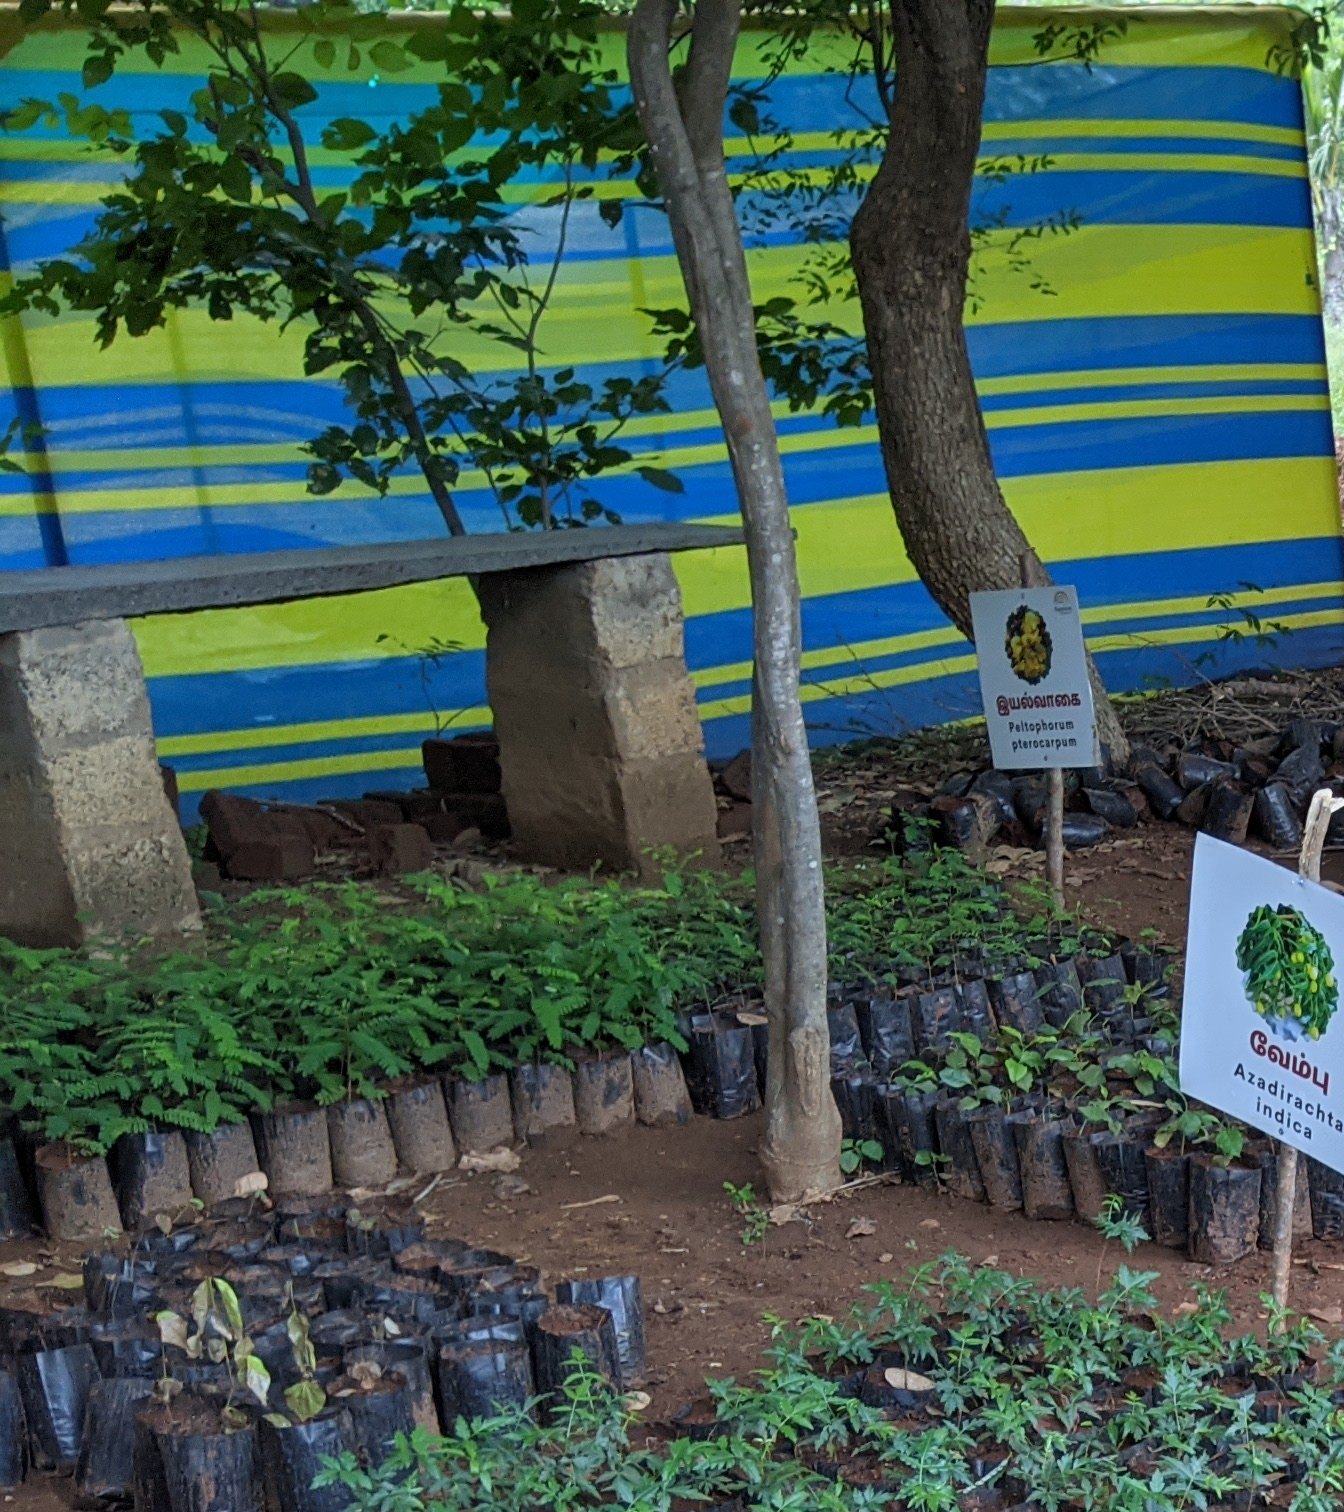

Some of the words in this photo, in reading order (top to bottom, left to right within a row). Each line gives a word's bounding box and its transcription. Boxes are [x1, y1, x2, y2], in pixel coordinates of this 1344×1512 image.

[996, 691, 1081, 716] இயல்வாகை
[1009, 719, 1075, 734] Peltophorum
[1012, 736, 1077, 752] pterocarpum
[1249, 1030, 1331, 1096] வேம்பு
[1234, 1062, 1344, 1133] Azadirachta
[1256, 1096, 1313, 1140] indica
